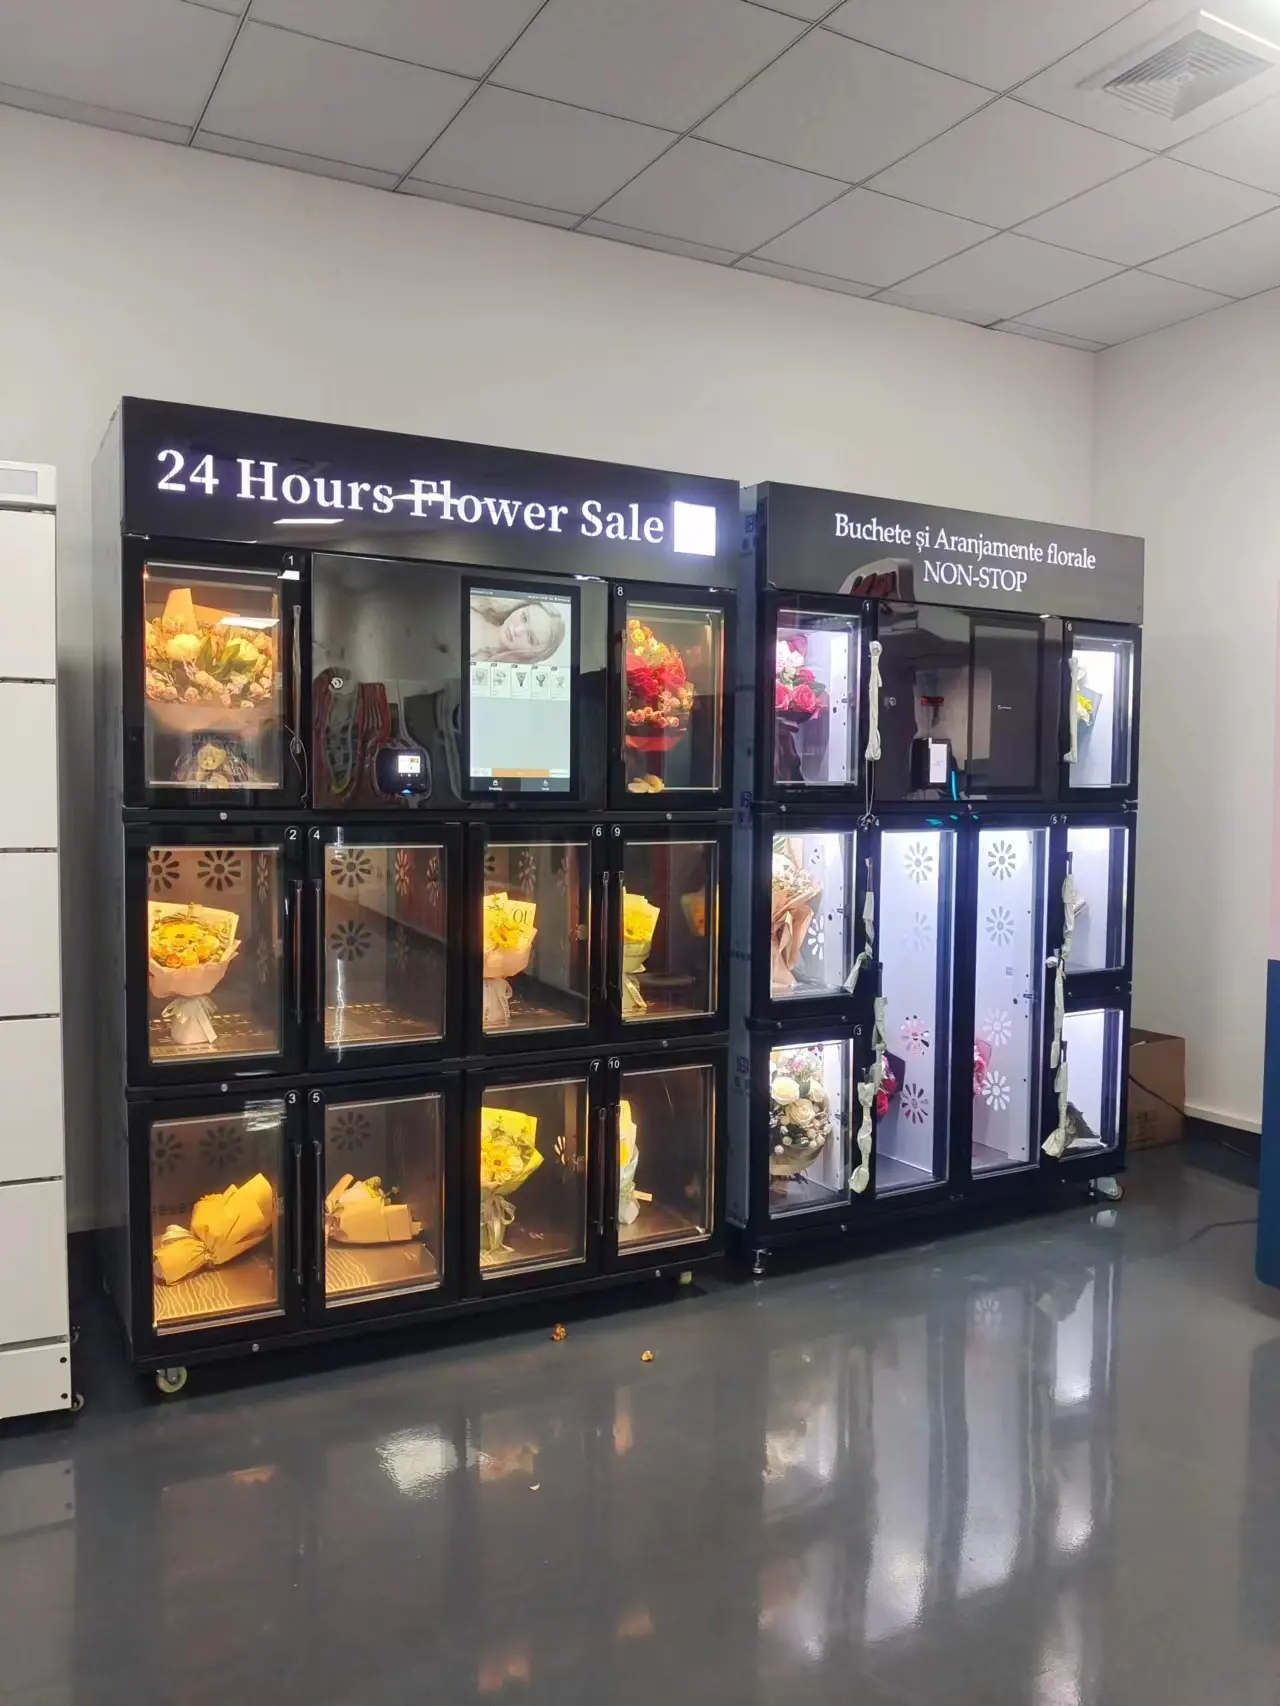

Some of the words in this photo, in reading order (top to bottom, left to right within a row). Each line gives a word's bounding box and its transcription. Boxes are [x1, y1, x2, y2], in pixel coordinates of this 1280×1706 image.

[157, 449, 220, 495] 24
[236, 458, 394, 515] Hours
[410, 479, 567, 533] Flower
[580, 499, 665, 544] Sale
[834, 512, 912, 545] Buchete
[935, 528, 1044, 563] Aranjamente
[1047, 542, 1097, 570] florale
[288, 555, 294, 566] 1
[923, 560, 1027, 592] NON-STOP
[617, 586, 624, 597] 8
[289, 829, 297, 840] 2
[313, 830, 321, 840] 4
[595, 827, 602, 837] 6
[615, 827, 622, 837] 9
[856, 1027, 862, 1036] 3
[593, 1062, 600, 1072] 7
[609, 1060, 620, 1070] 10
[288, 1093, 296, 1104] 3
[312, 1092, 320, 1103] 5
